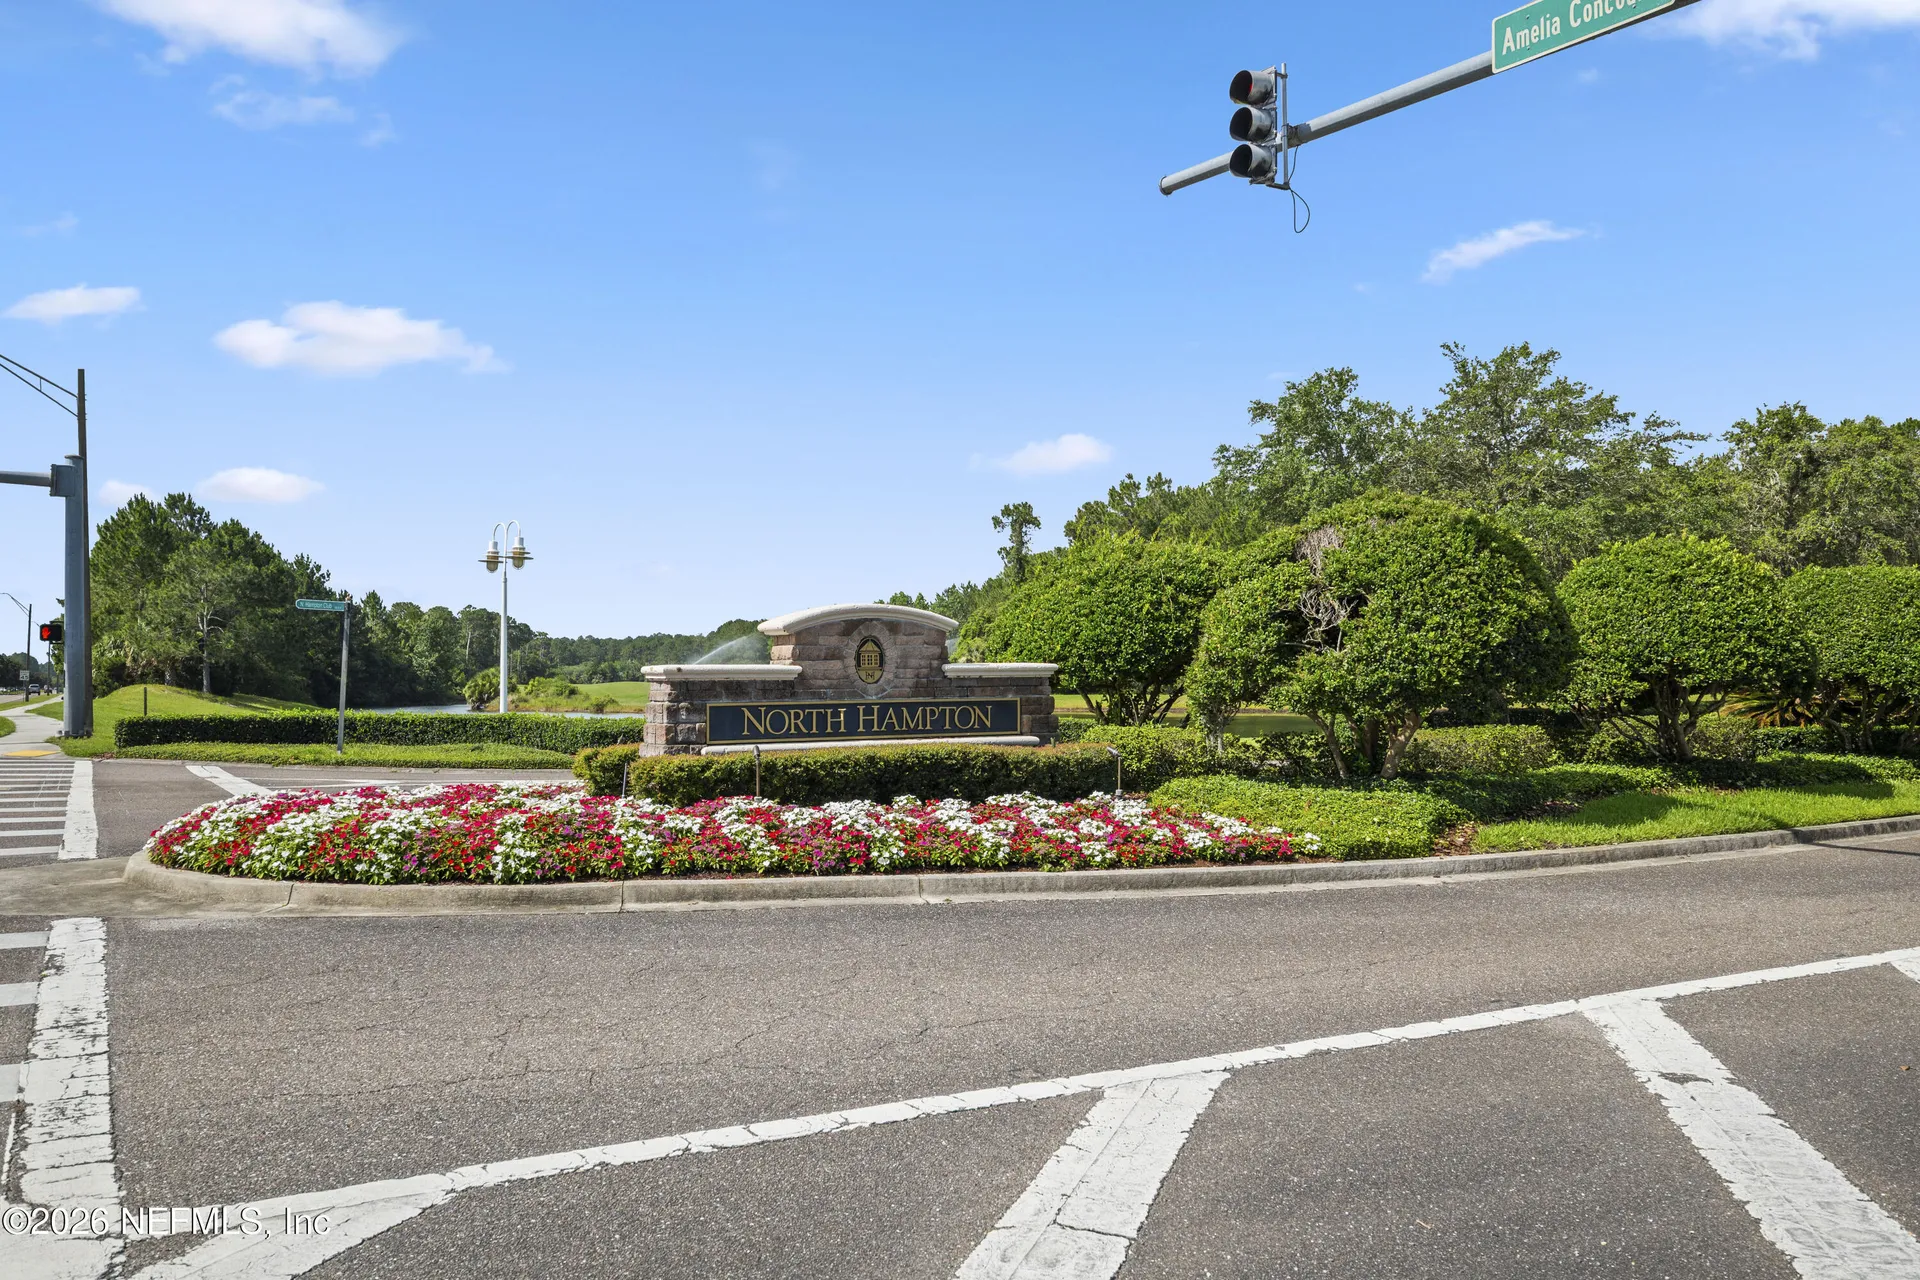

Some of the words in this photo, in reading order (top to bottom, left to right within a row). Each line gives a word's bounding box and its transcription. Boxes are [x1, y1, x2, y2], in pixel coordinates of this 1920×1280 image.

[1502, 14, 1561, 55] Amelia
[1569, 0, 1637, 27] Conco
[741, 707, 846, 736] NORTH
[857, 705, 992, 732] HAMPTON
